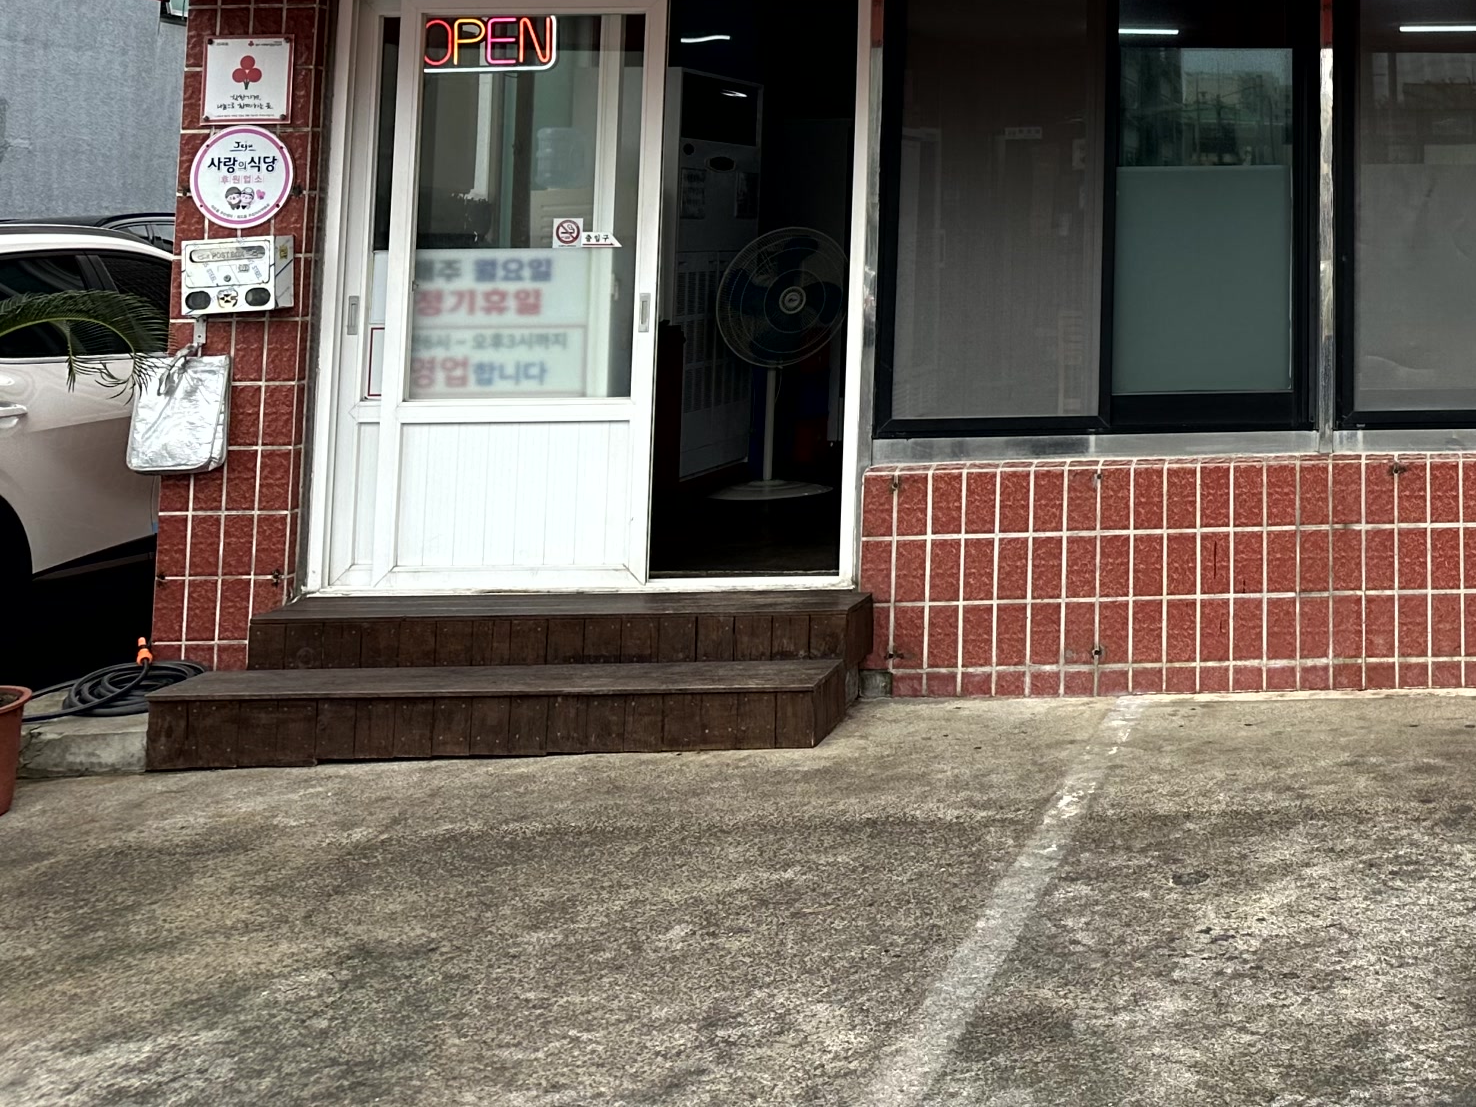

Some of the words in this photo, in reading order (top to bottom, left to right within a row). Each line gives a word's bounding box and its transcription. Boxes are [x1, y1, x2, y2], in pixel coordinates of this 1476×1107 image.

[424, 17, 552, 66] OPEN
[220, 175, 263, 184] 후원업소
[585, 234, 609, 243] 출입구
